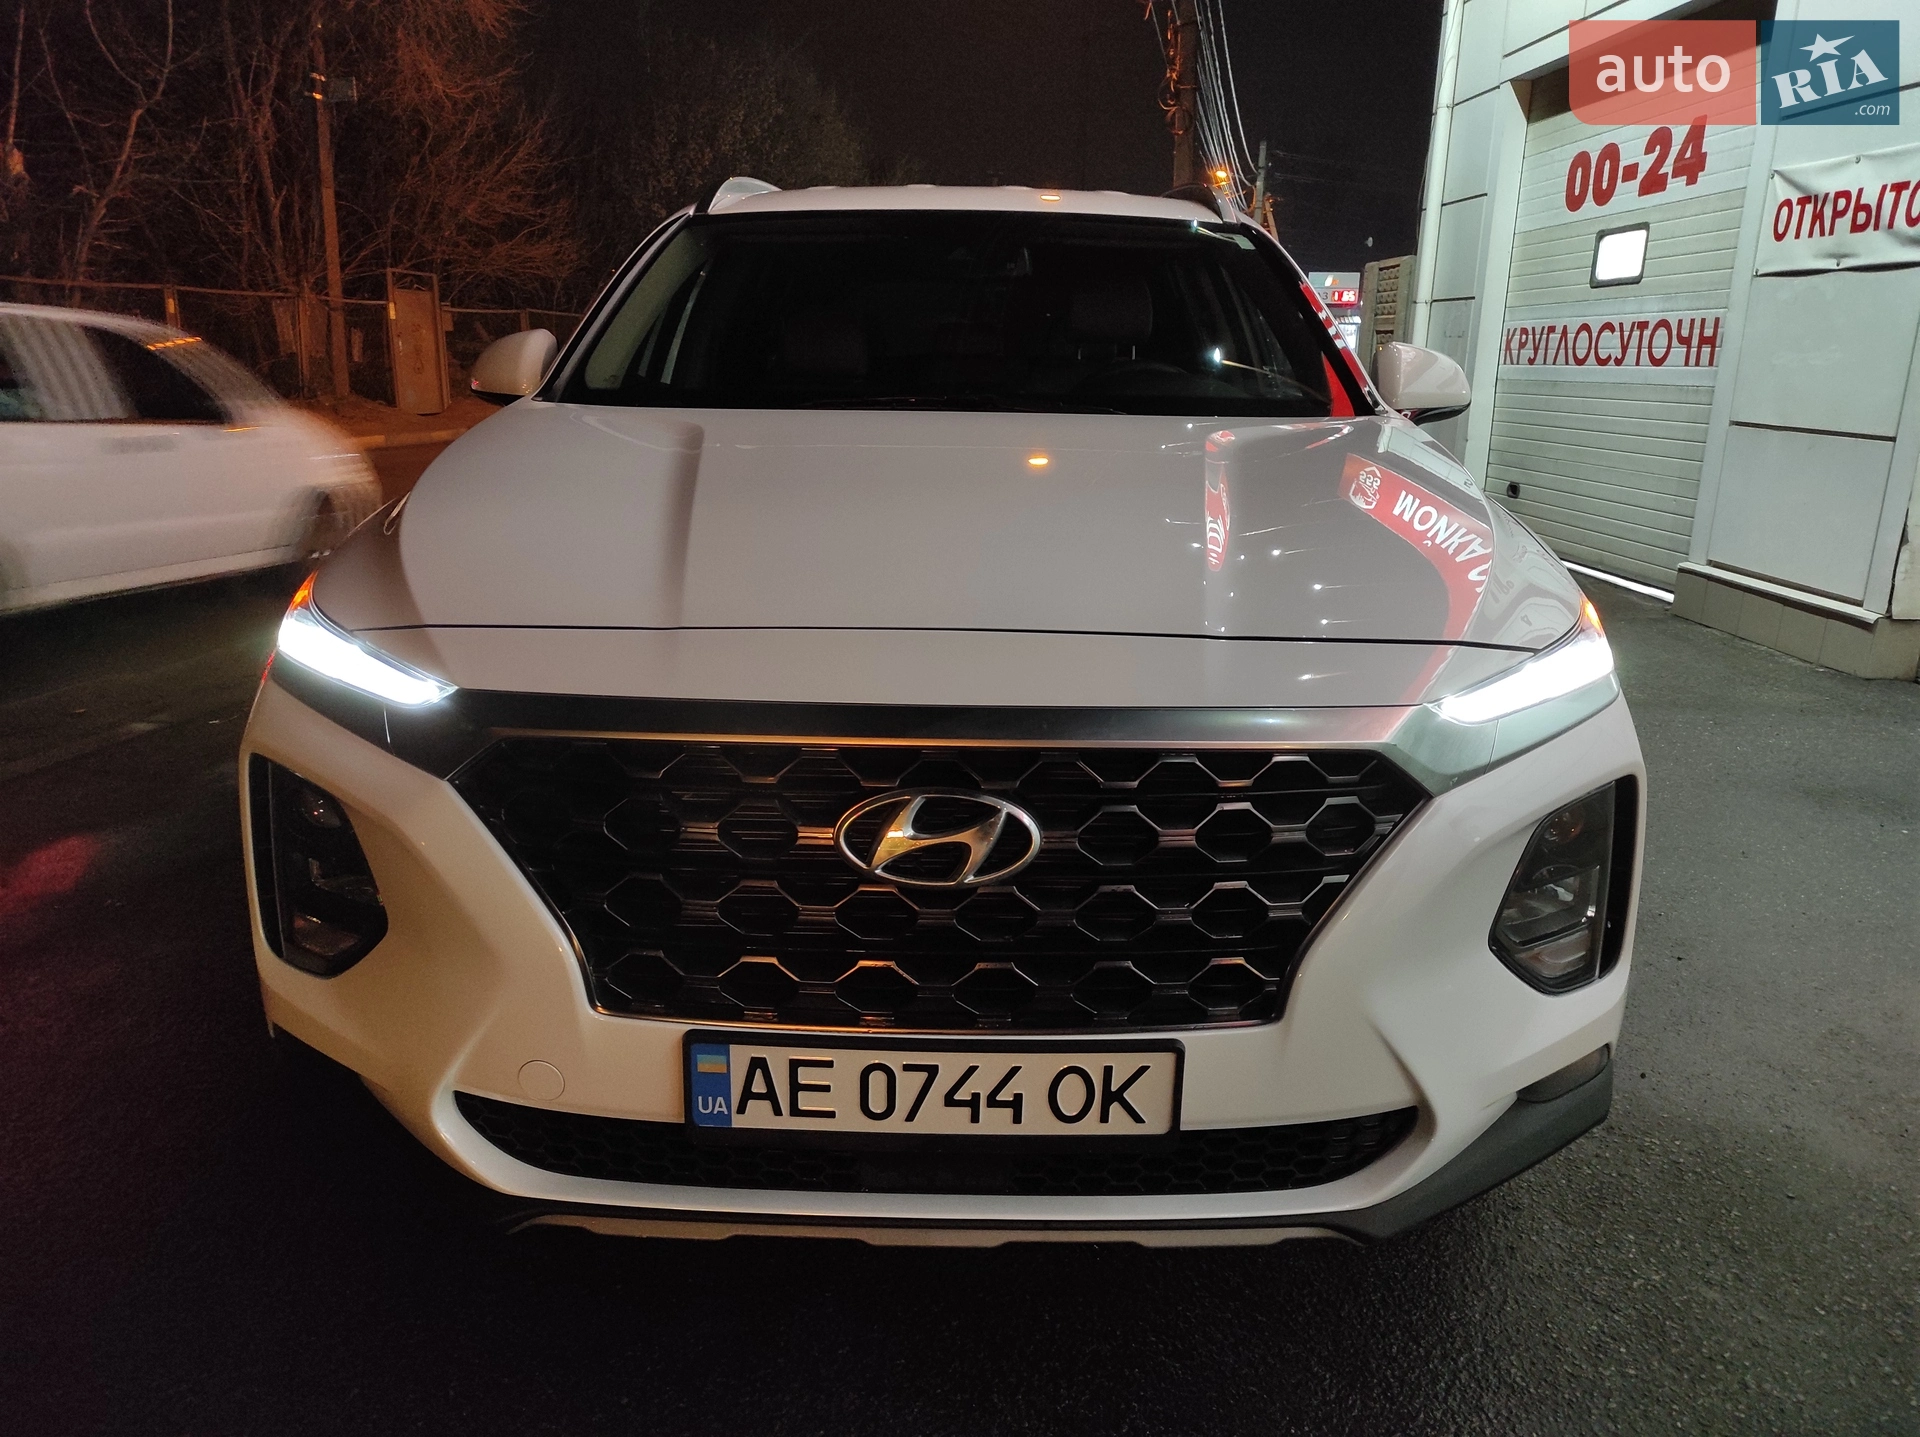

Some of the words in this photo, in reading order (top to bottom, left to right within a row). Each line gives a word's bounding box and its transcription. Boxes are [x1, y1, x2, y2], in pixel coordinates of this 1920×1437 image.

[1565, 114, 1708, 213] 00-24
[1504, 316, 1720, 367] КРУГЛОСУТОЧН
[698, 1096, 728, 1116] UA
[736, 1055, 837, 1119] AE
[859, 1061, 1024, 1125] 0744
[1047, 1064, 1151, 1125] OK
